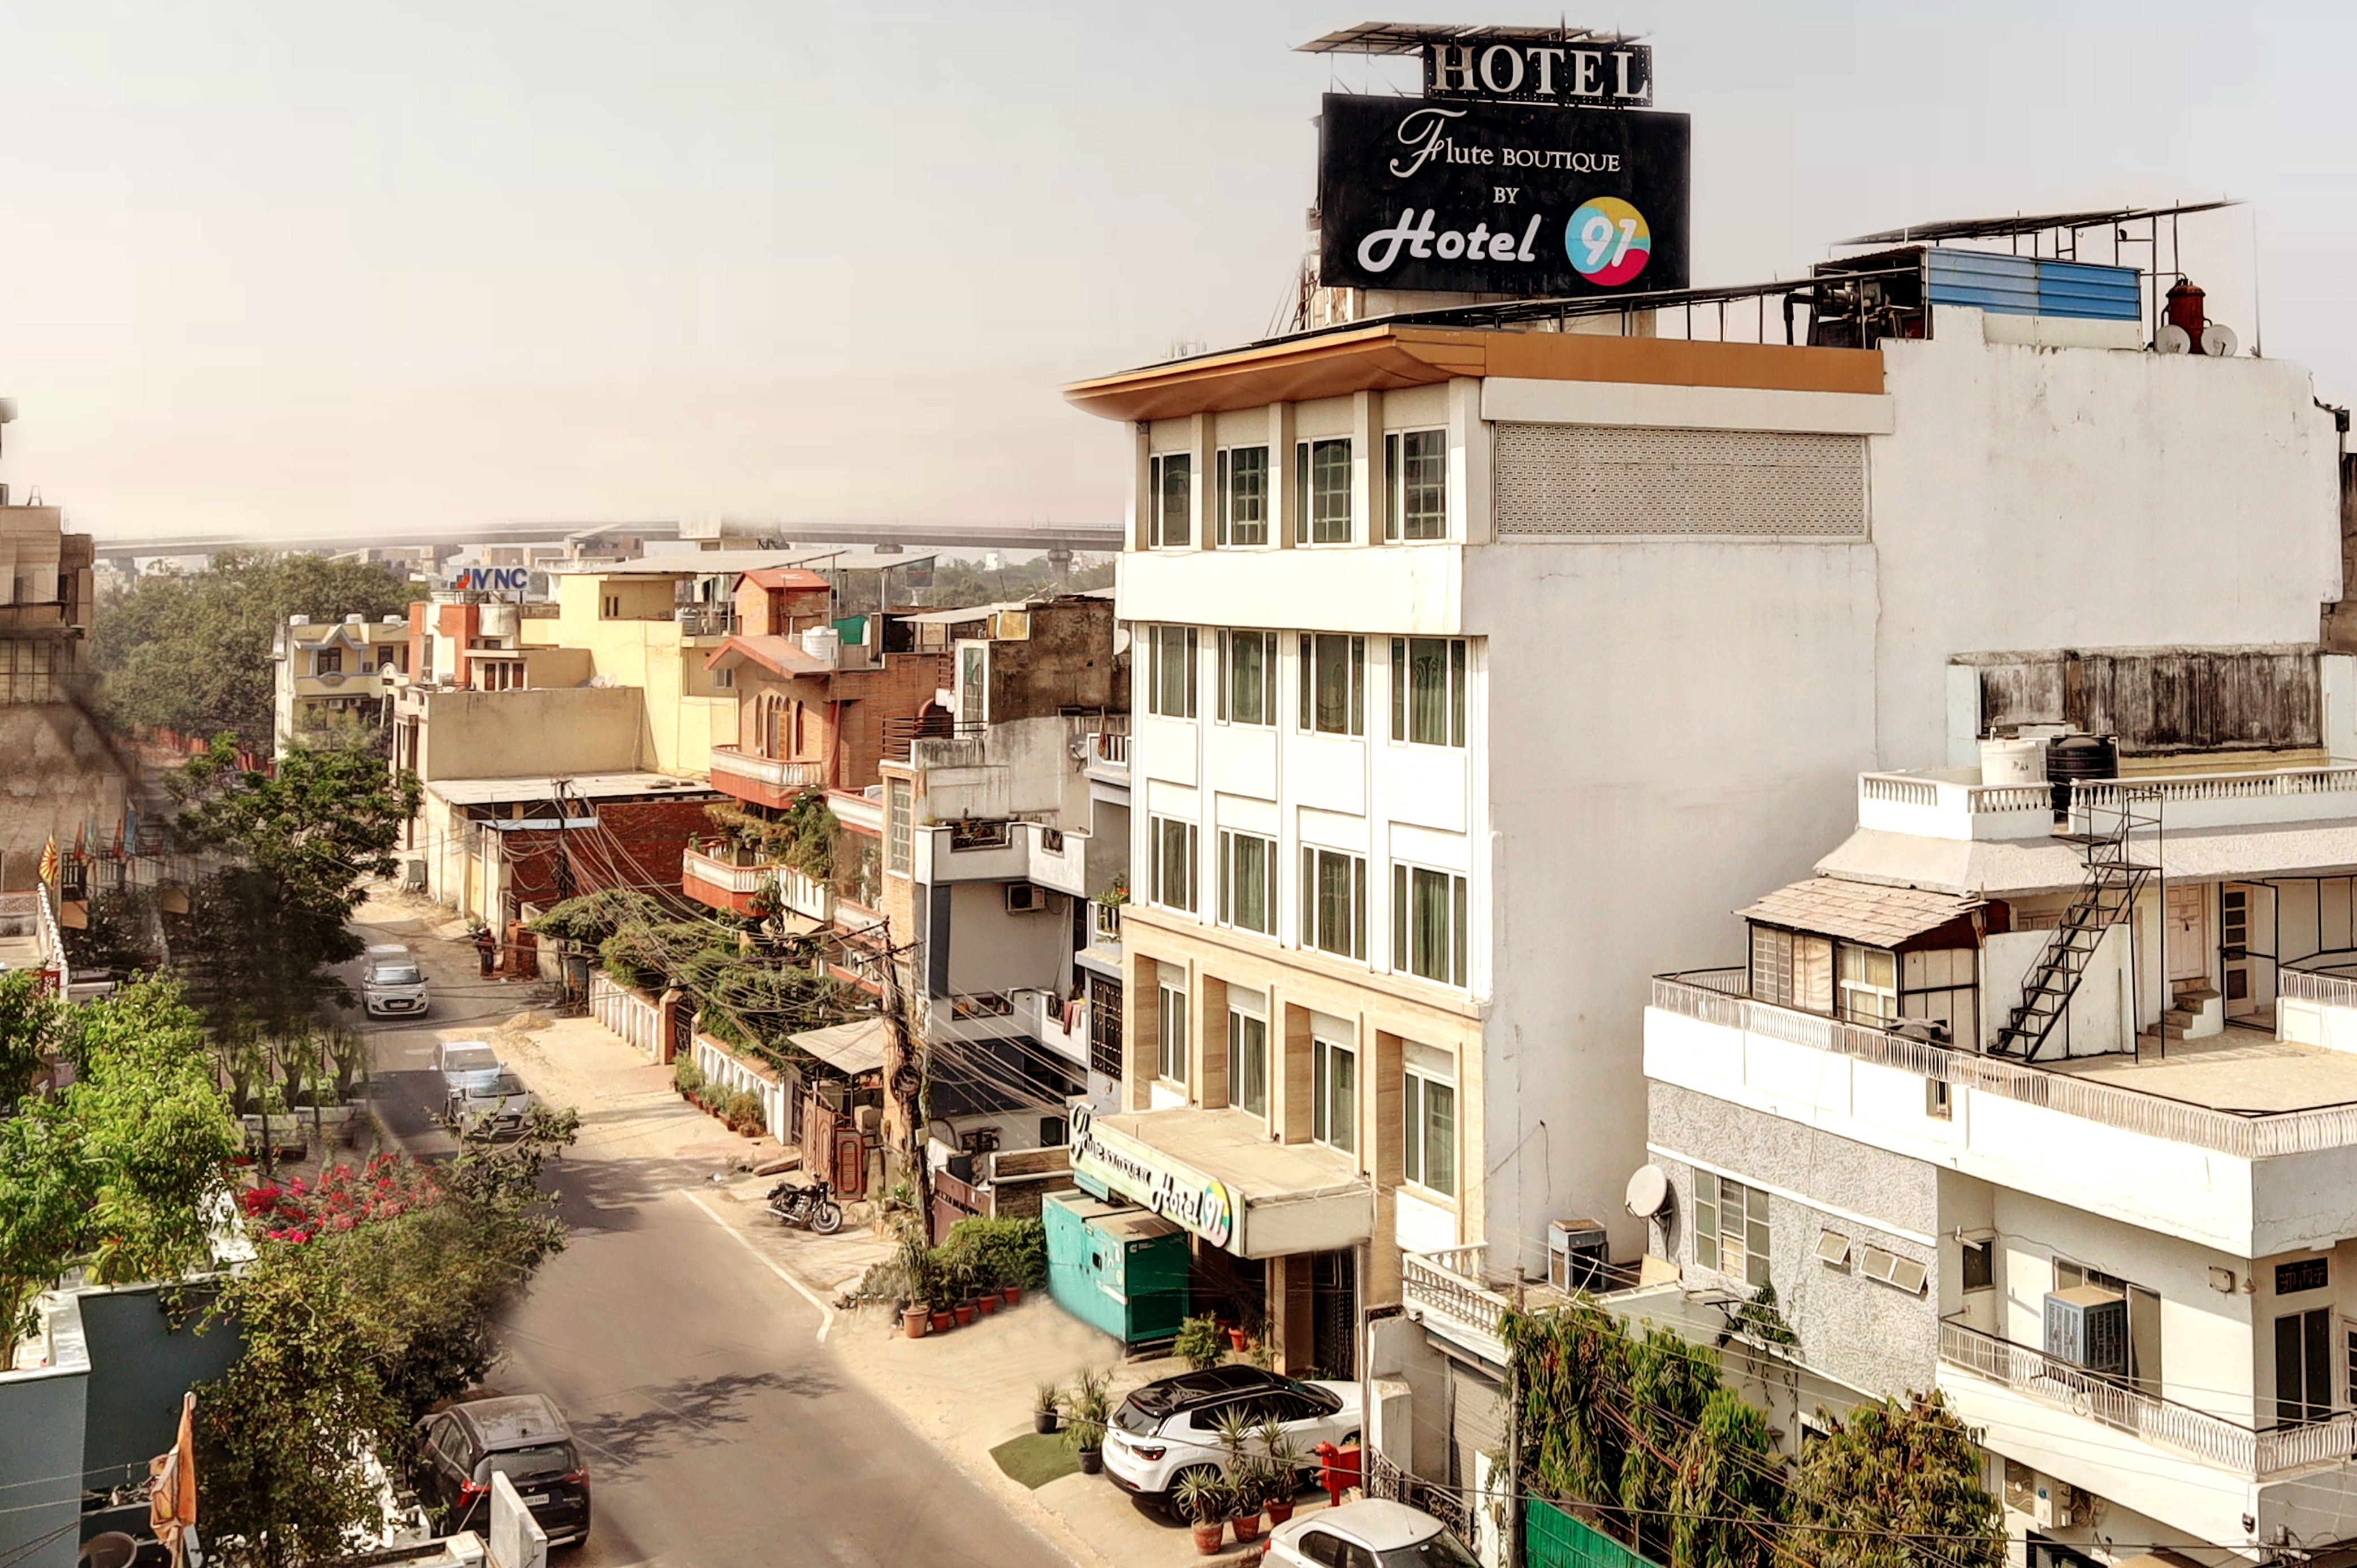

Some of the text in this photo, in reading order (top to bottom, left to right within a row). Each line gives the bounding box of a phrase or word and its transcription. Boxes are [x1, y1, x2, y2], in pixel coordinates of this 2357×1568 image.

[1430, 44, 1649, 99] HOTEL
[1390, 108, 1621, 178] Flute BOUTIQUE
[1493, 187, 1520, 204] BY
[1357, 207, 1637, 272] Hotel 91
[1150, 1172, 1203, 1227] Hotel
[1205, 1192, 1225, 1236] 91
